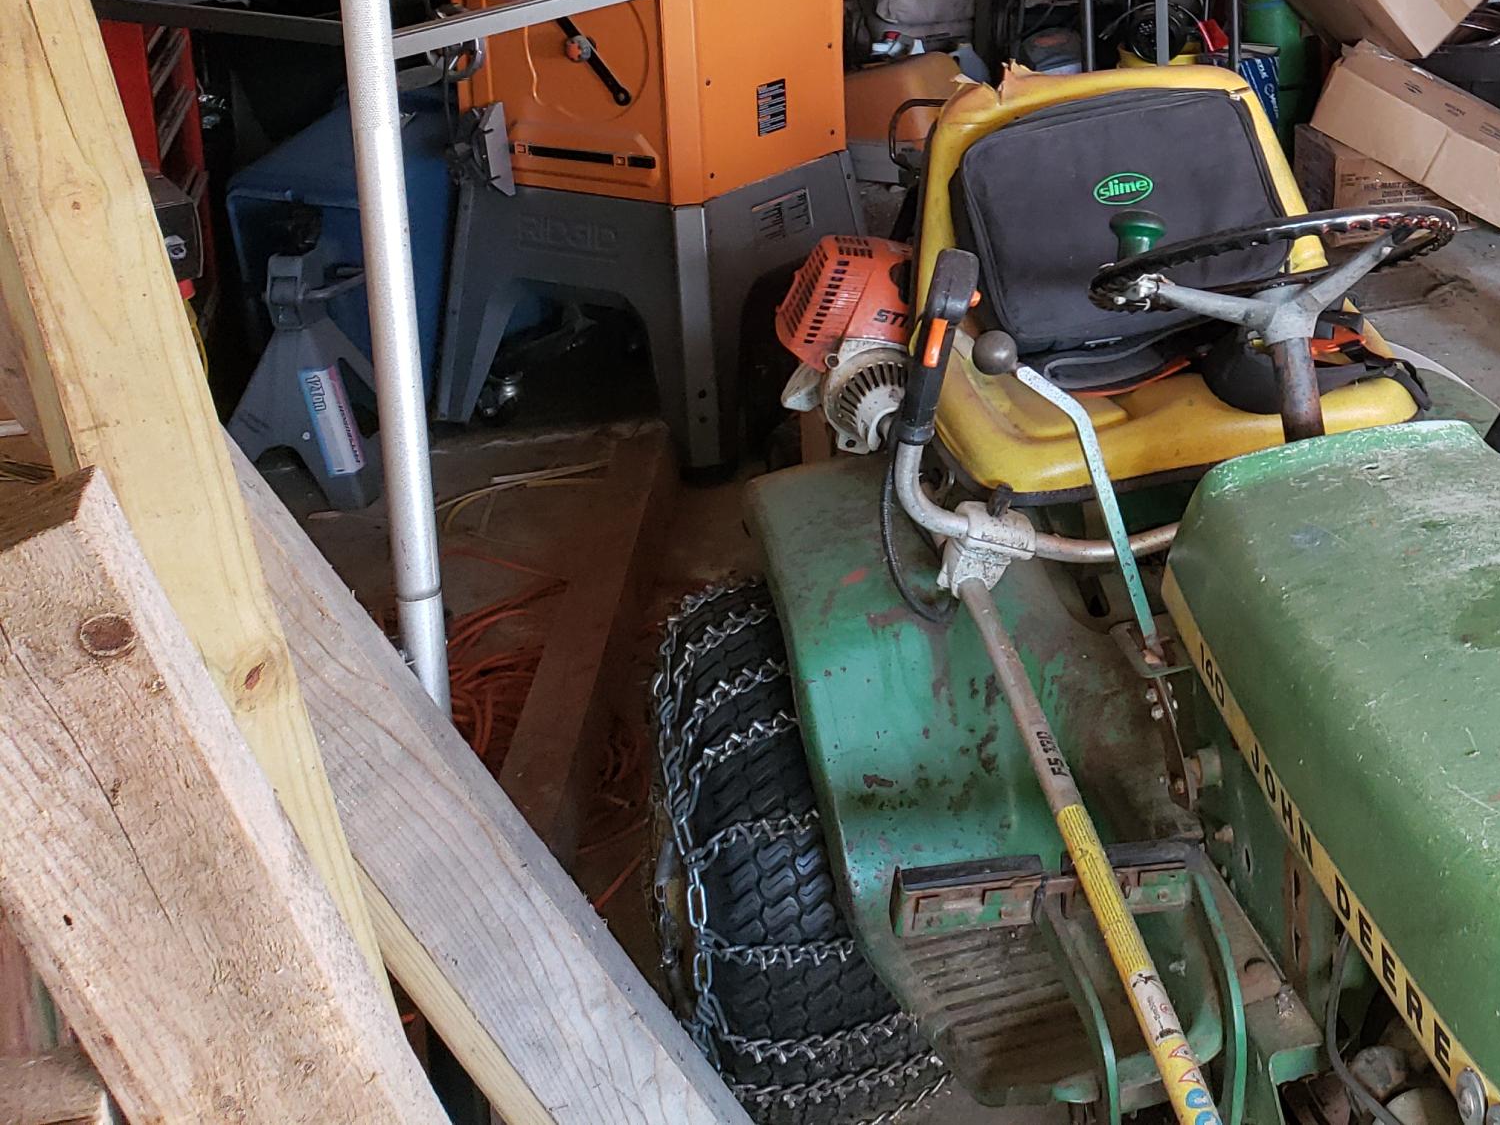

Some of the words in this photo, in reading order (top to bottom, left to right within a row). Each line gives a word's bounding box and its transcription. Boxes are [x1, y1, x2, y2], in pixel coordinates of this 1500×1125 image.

[1098, 179, 1149, 200] slime
[873, 308, 908, 328] STI
[1250, 742, 1314, 868] JOHN
[1334, 873, 1452, 1076] DEERE
